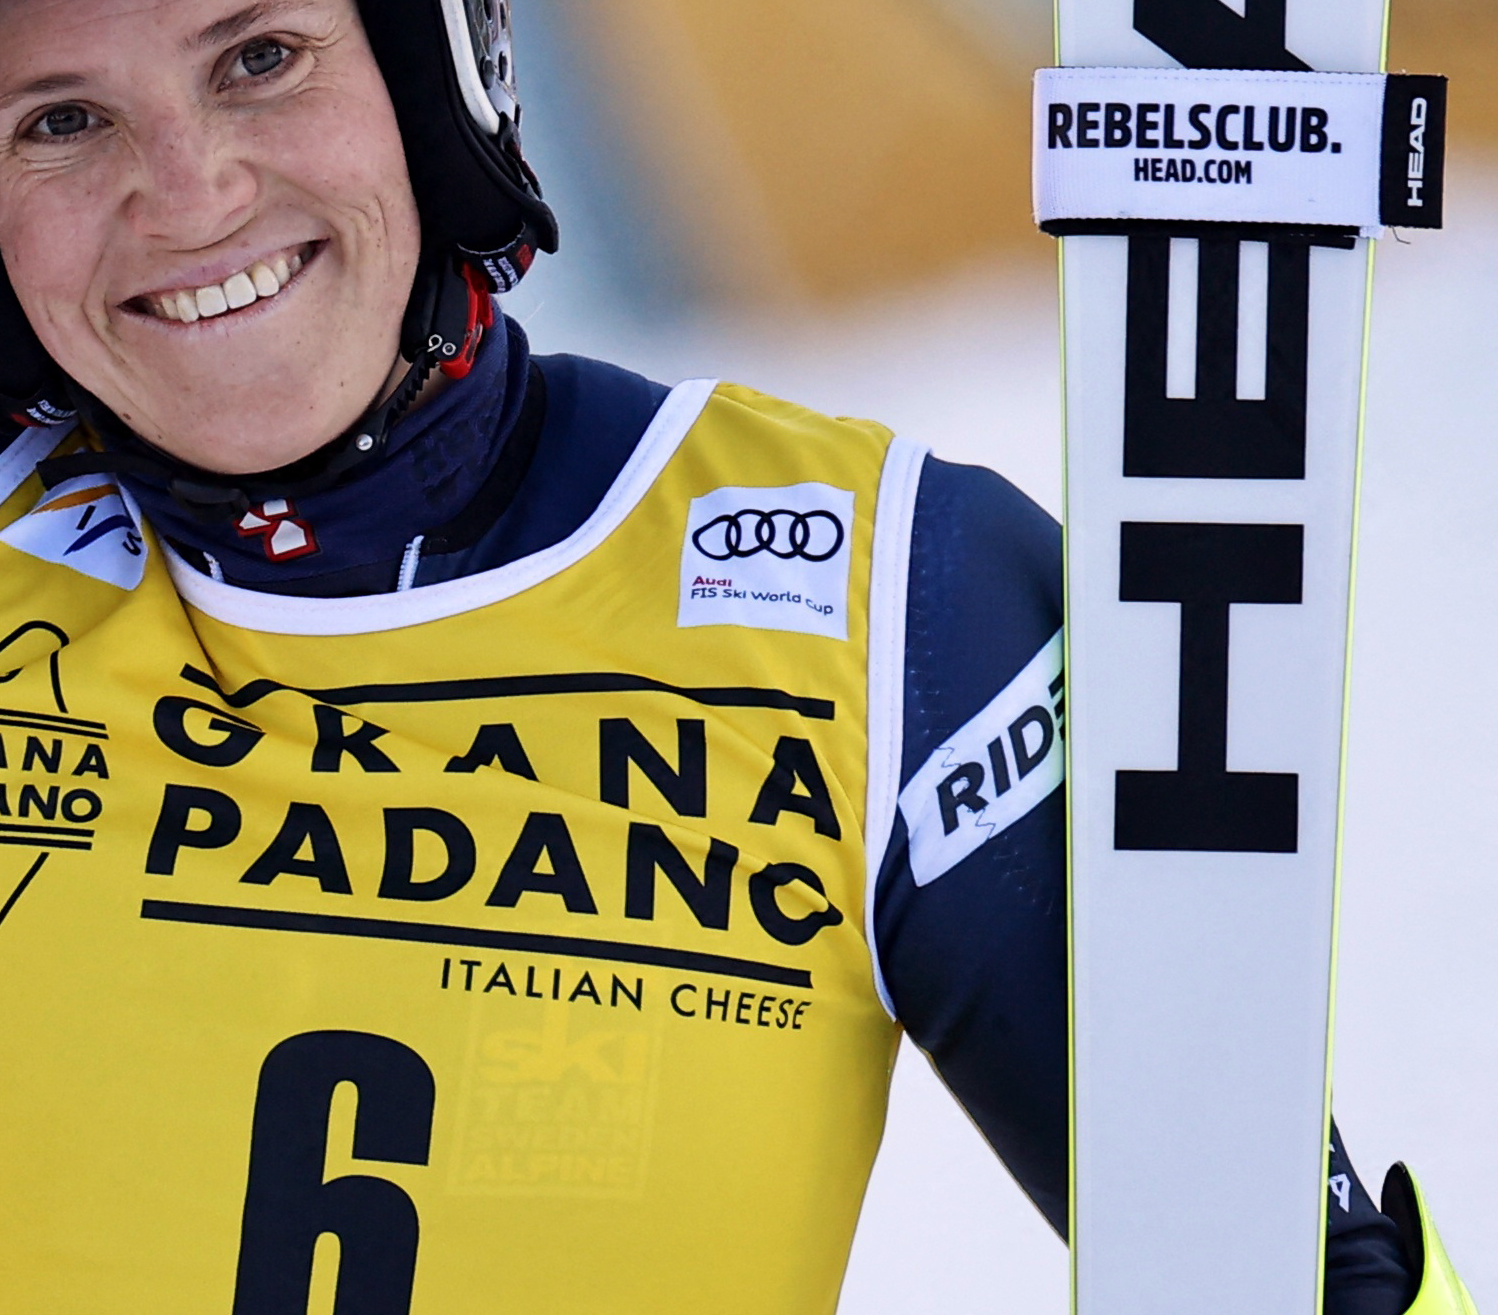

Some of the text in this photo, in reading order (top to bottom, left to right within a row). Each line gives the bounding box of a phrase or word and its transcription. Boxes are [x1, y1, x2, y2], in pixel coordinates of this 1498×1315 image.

[1046, 102, 1342, 154] REBELSCLUB.
[1404, 95, 1427, 208] HEAD
[1133, 158, 1253, 186] HEAD.COM
[691, 587, 834, 616] FIS Ski World Cup
[692, 575, 732, 587] Audi
[146, 783, 846, 947] PADANO
[440, 953, 814, 1032] ITALIAN CHEESE
